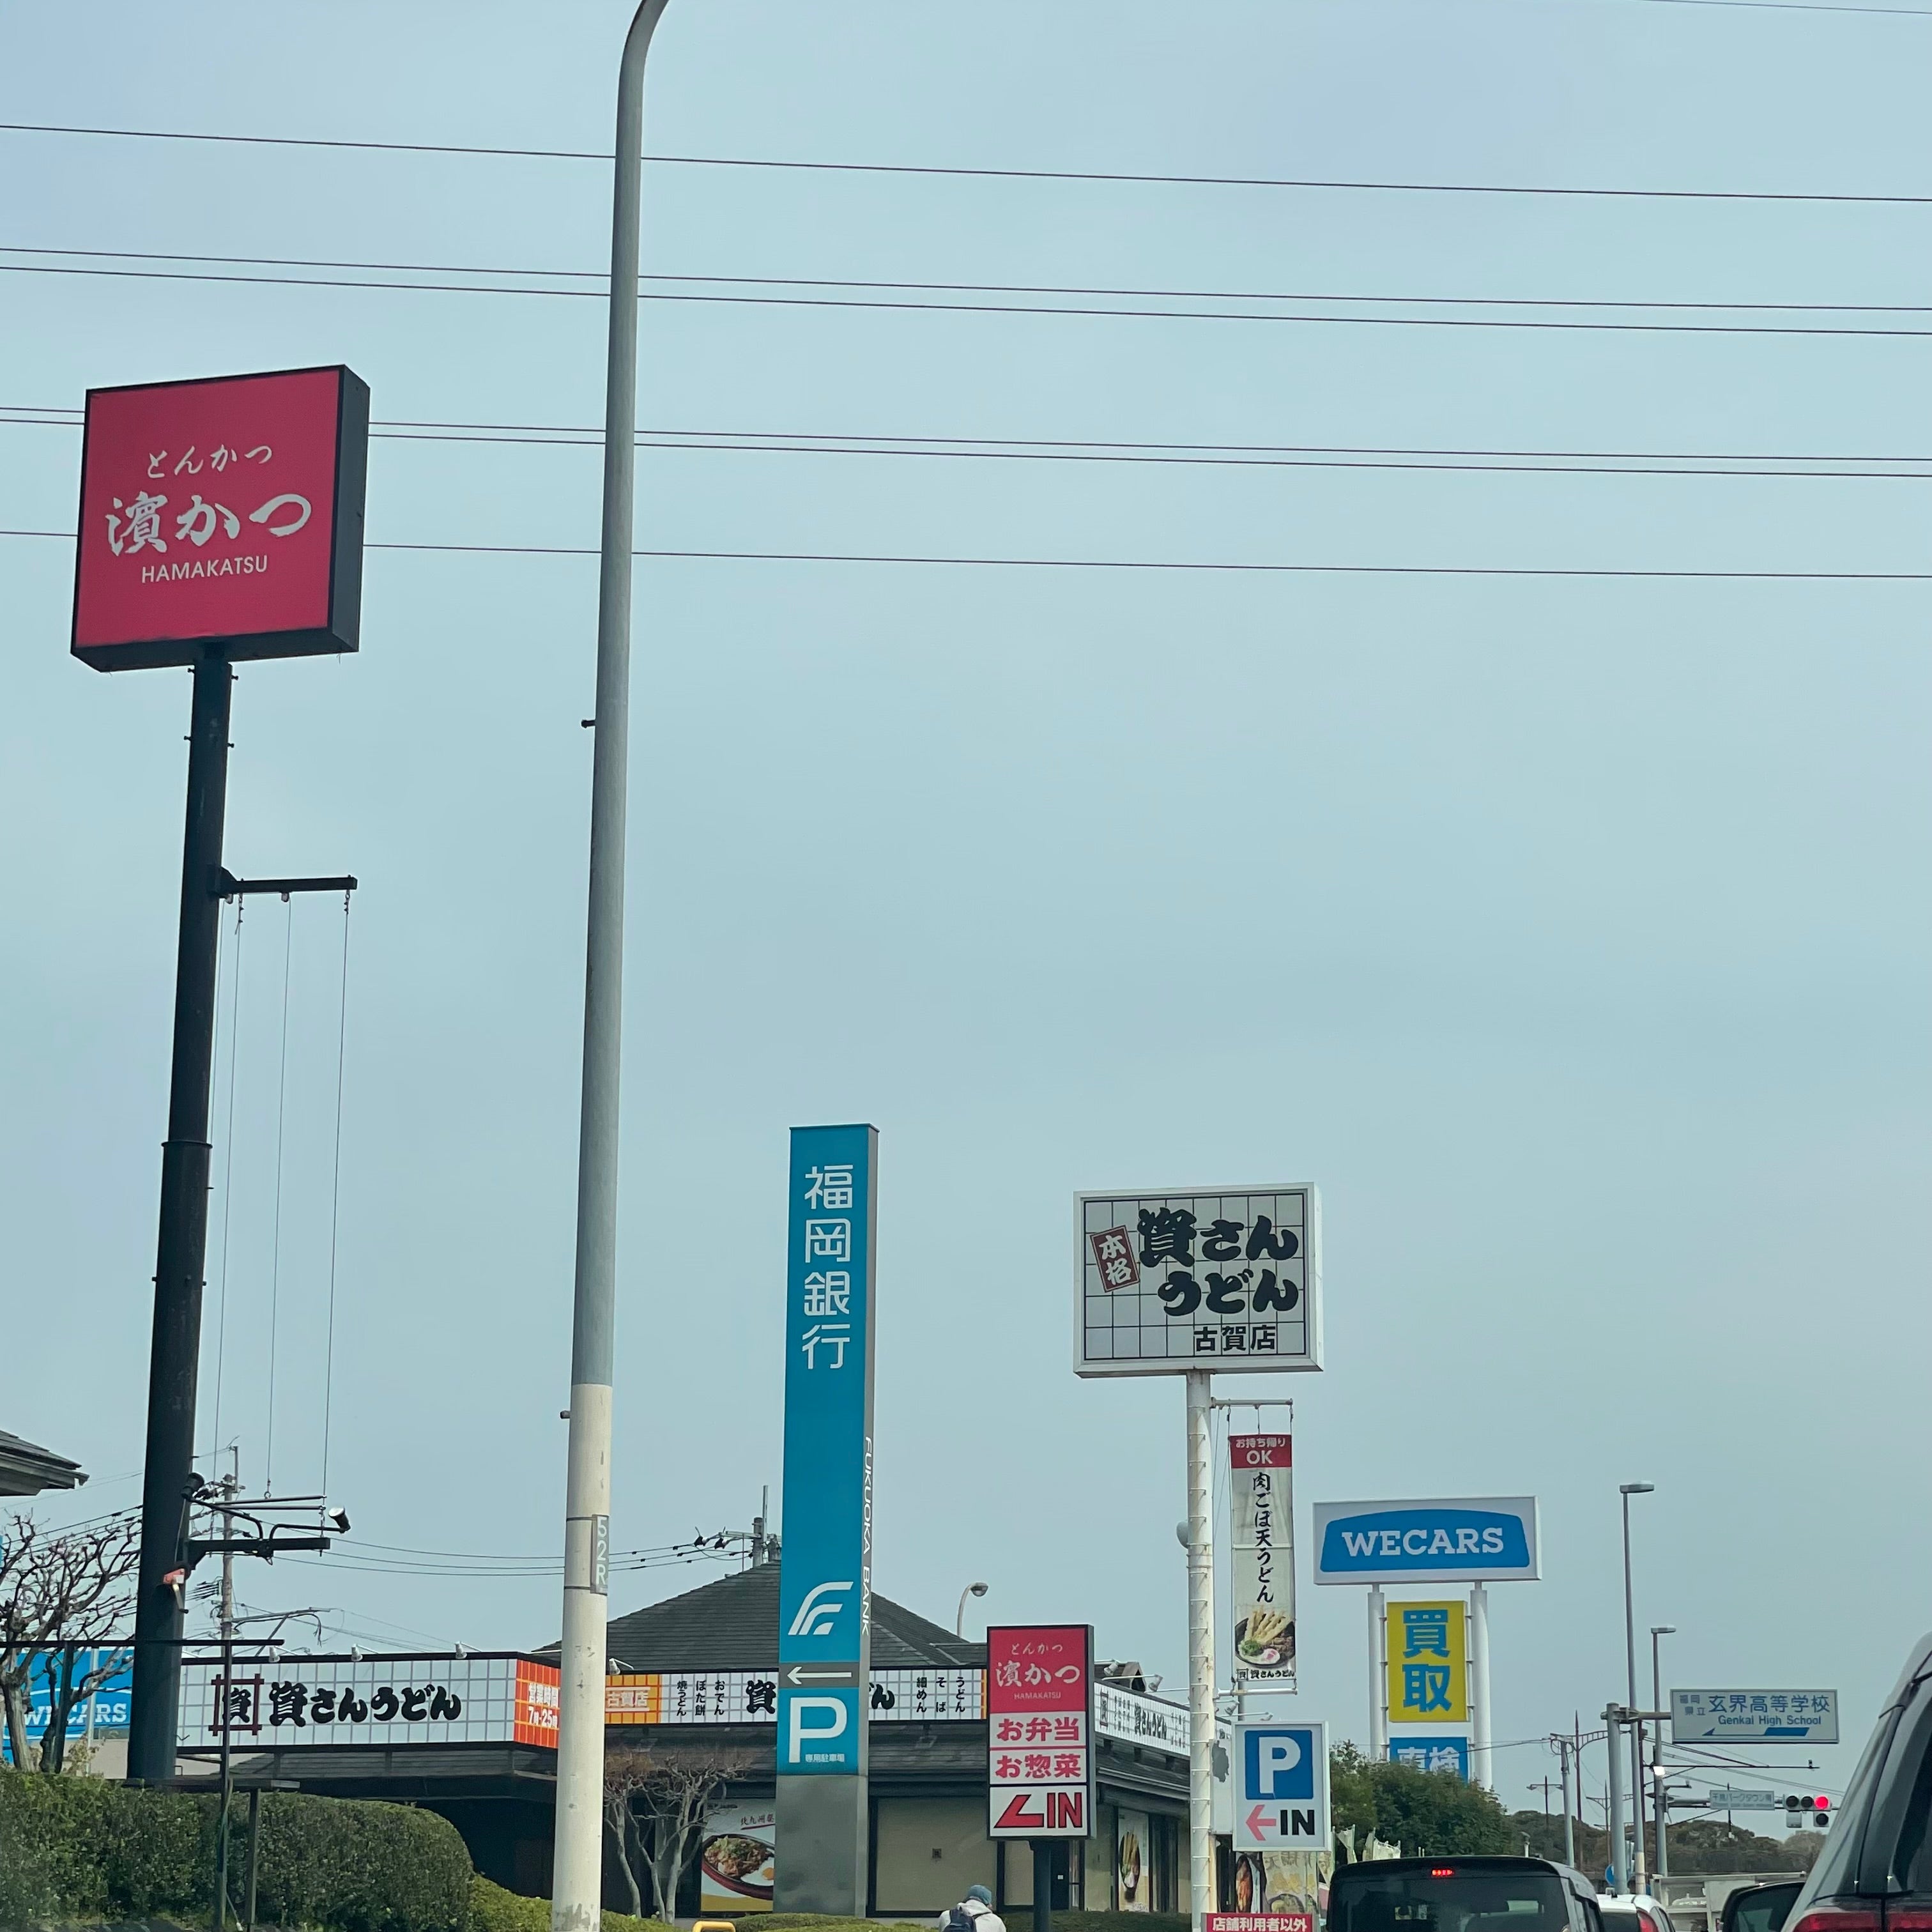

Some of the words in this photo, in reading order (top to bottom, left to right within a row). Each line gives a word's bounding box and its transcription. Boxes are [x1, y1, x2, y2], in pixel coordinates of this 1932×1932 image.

[147, 444, 273, 479] とんかつ
[105, 490, 312, 557] 濱かつ
[141, 555, 268, 584] HAMAKATSU
[1137, 1207, 1299, 1268] 資さん
[802, 1164, 854, 1370] 福岡銀行
[1100, 1234, 1133, 1285] 本格
[1157, 1268, 1299, 1317] うどん
[1193, 1324, 1276, 1352] 古賀店
[1236, 1437, 1286, 1449] お持ち帰り
[1246, 1450, 1273, 1465] OK
[864, 1436, 873, 1554] FUKUOKA
[1252, 1471, 1274, 1604] 肉ごぼ天うどん
[1342, 1528, 1504, 1556] WECARS
[1011, 1643, 1062, 1655] とんかつ
[1402, 1609, 1452, 1712] 買取
[996, 1660, 1080, 1687] 濱かつ
[269, 1681, 461, 1728] 資さんうどん
[676, 1680, 687, 1717] 焼うどん
[714, 1680, 724, 1716] おでん
[916, 1676, 927, 1713] 細めん
[936, 1676, 946, 1712] そば
[955, 1676, 965, 1712] うどん
[1014, 1691, 1061, 1700] HAMAKATSU
[1708, 1694, 1830, 1713] 玄界高等学校
[789, 1697, 848, 1763] P
[997, 1717, 1080, 1742] お弁当
[1718, 1715, 1754, 1725] Genkai
[1759, 1715, 1782, 1726] High
[1787, 1715, 1821, 1725] School
[995, 1754, 1081, 1778] お惣菜
[1259, 1736, 1301, 1795] P
[1047, 1792, 1082, 1828] IN
[1280, 1809, 1315, 1836] IN
[1213, 1917, 1307, 1932] 店舗利用者以外
